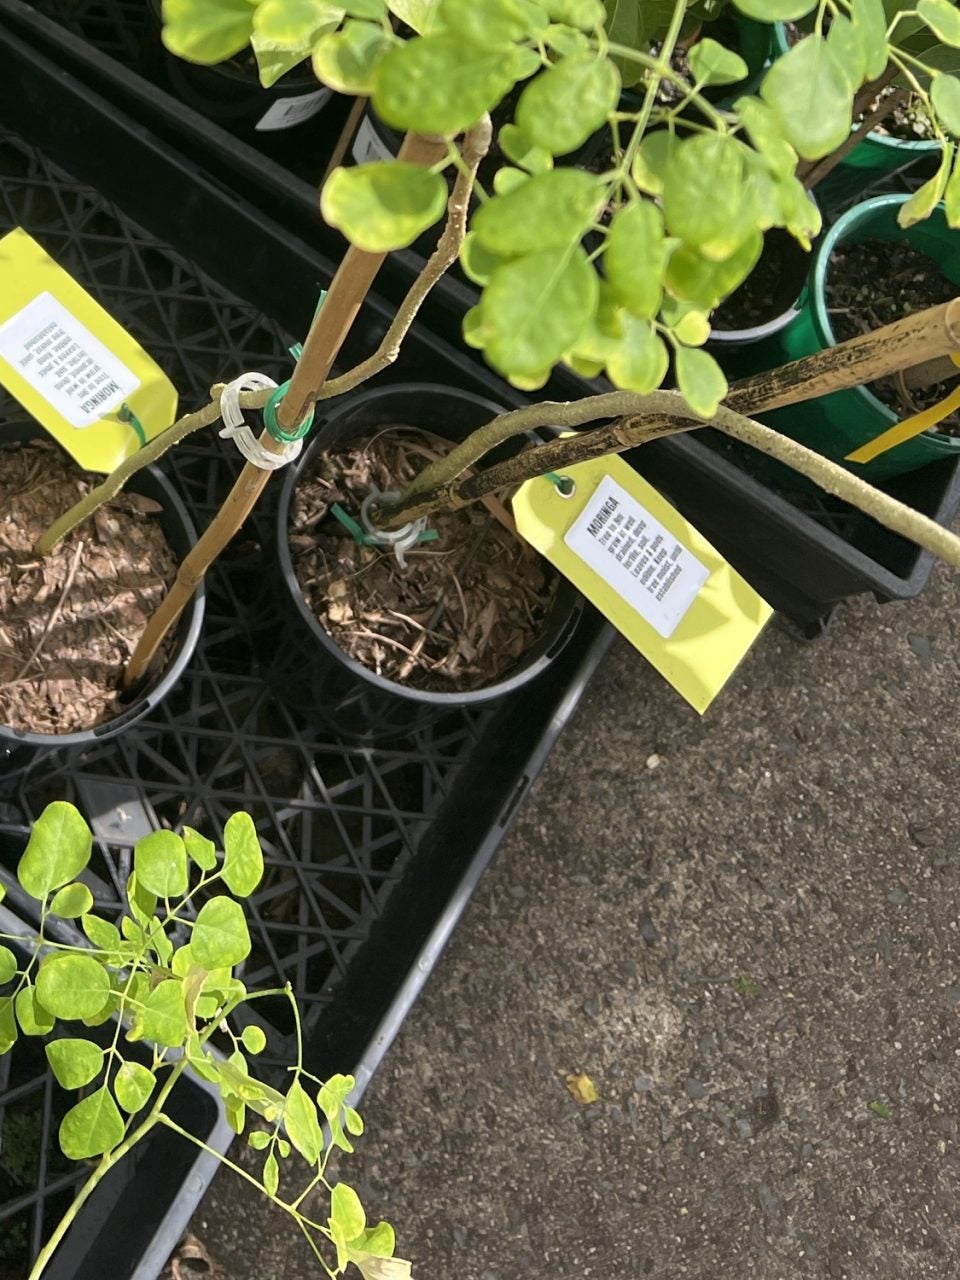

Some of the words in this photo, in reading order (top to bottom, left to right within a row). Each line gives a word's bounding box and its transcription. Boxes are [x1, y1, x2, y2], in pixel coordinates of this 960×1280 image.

[78, 379, 121, 414] MORINGA
[585, 494, 620, 538] MORINGA
[597, 529, 612, 547] Tree
[607, 521, 617, 533] to
[606, 535, 622, 555] grow
[617, 528, 627, 539] in
[622, 515, 637, 532] well
[631, 518, 647, 538] deep
[629, 553, 650, 578] Leaves
[648, 532, 664, 552] pods
[645, 577, 660, 595] tree
[668, 543, 684, 562] until
[652, 546, 668, 566] Keep
[654, 563, 683, 602] established
